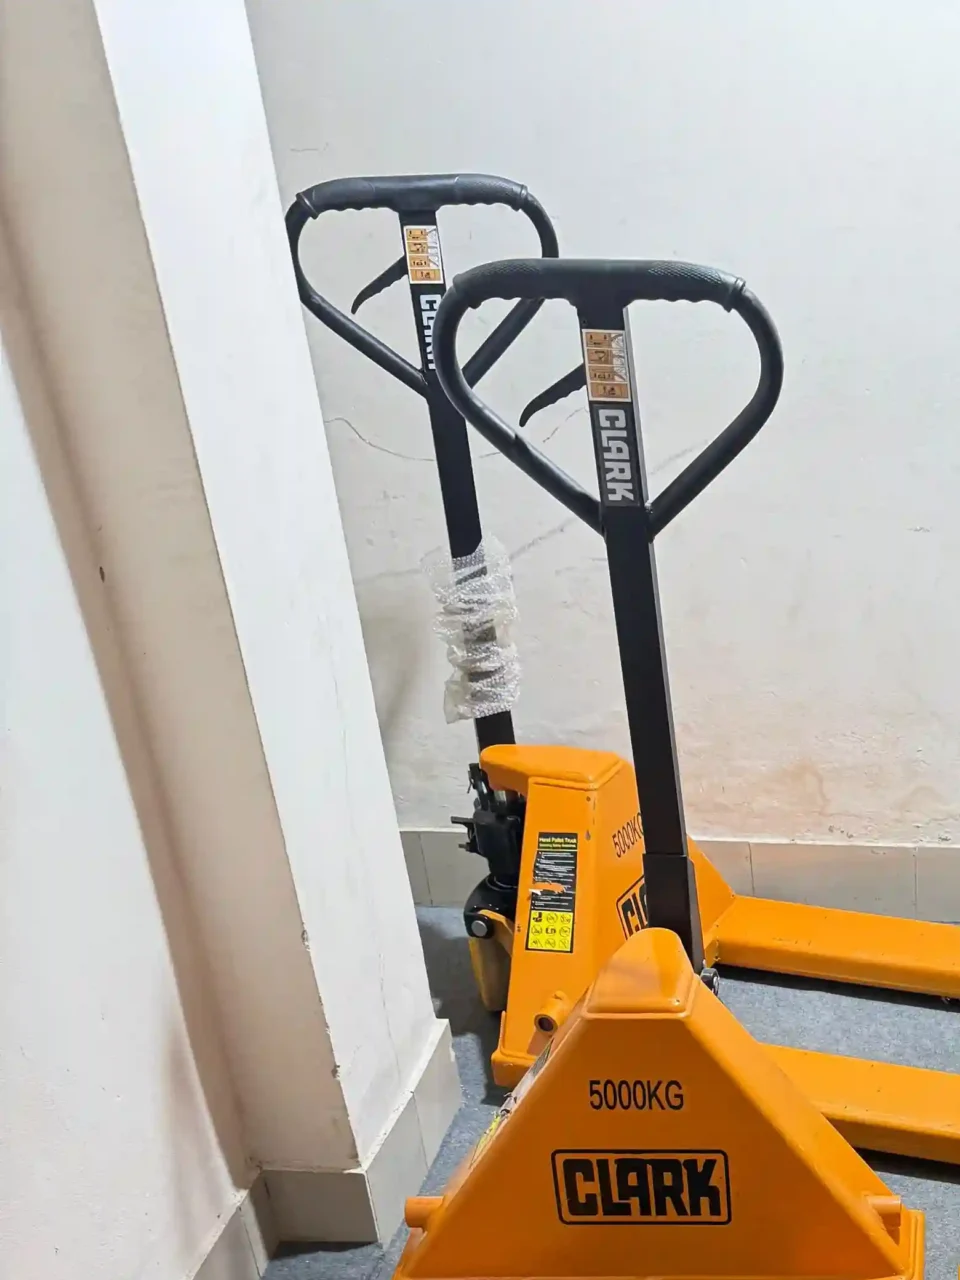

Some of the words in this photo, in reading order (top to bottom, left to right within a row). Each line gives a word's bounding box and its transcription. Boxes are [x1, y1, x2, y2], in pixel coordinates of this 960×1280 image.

[599, 409, 634, 501] CLARK
[589, 1079, 684, 1111] 5000KG
[562, 1159, 721, 1216] CLARK
